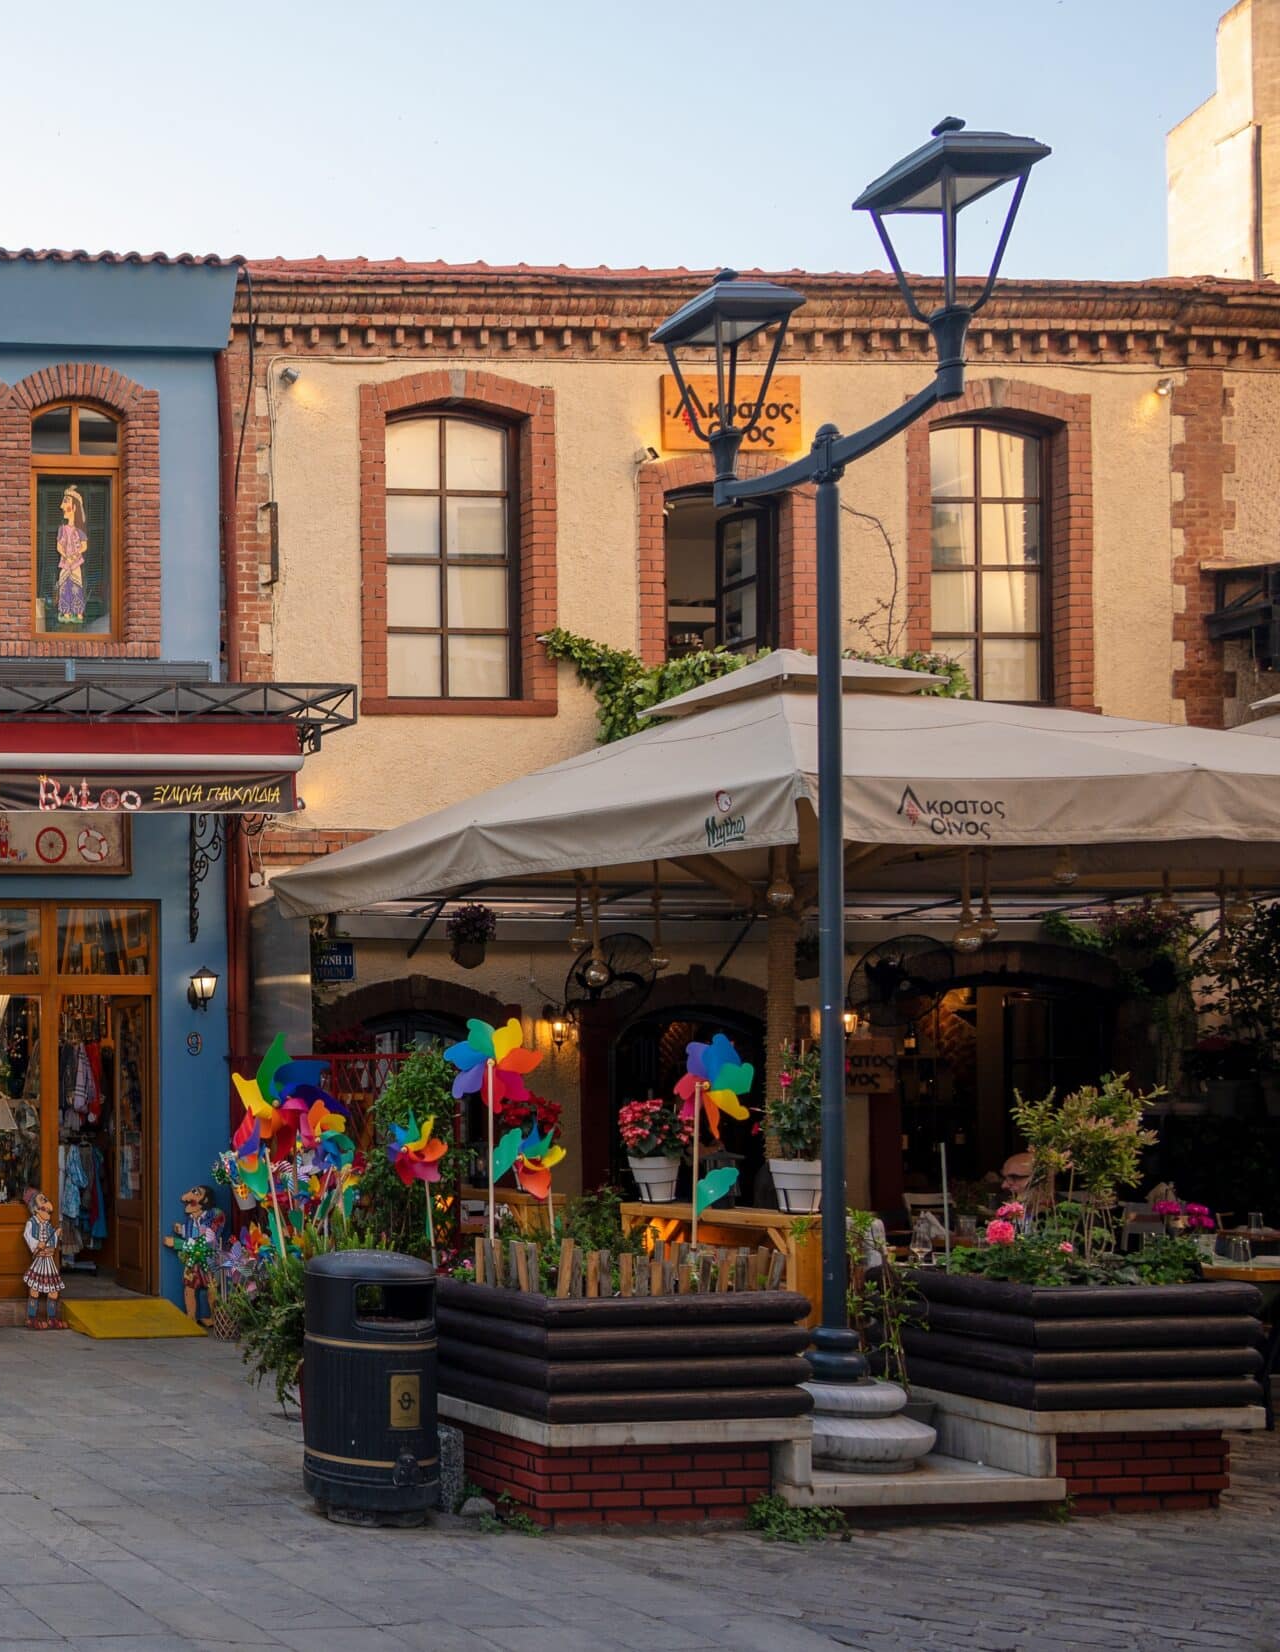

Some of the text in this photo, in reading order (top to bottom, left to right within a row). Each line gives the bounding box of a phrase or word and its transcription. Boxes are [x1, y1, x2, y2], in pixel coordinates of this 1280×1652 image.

[152, 785, 203, 804] ΞΥΛΙΝΑ
[207, 785, 281, 804] ΠΑΙΧΝΙΔΙΑ
[897, 784, 1005, 819] Ακρατος
[930, 816, 991, 840] Οίνος
[187, 1032, 202, 1056] 9
